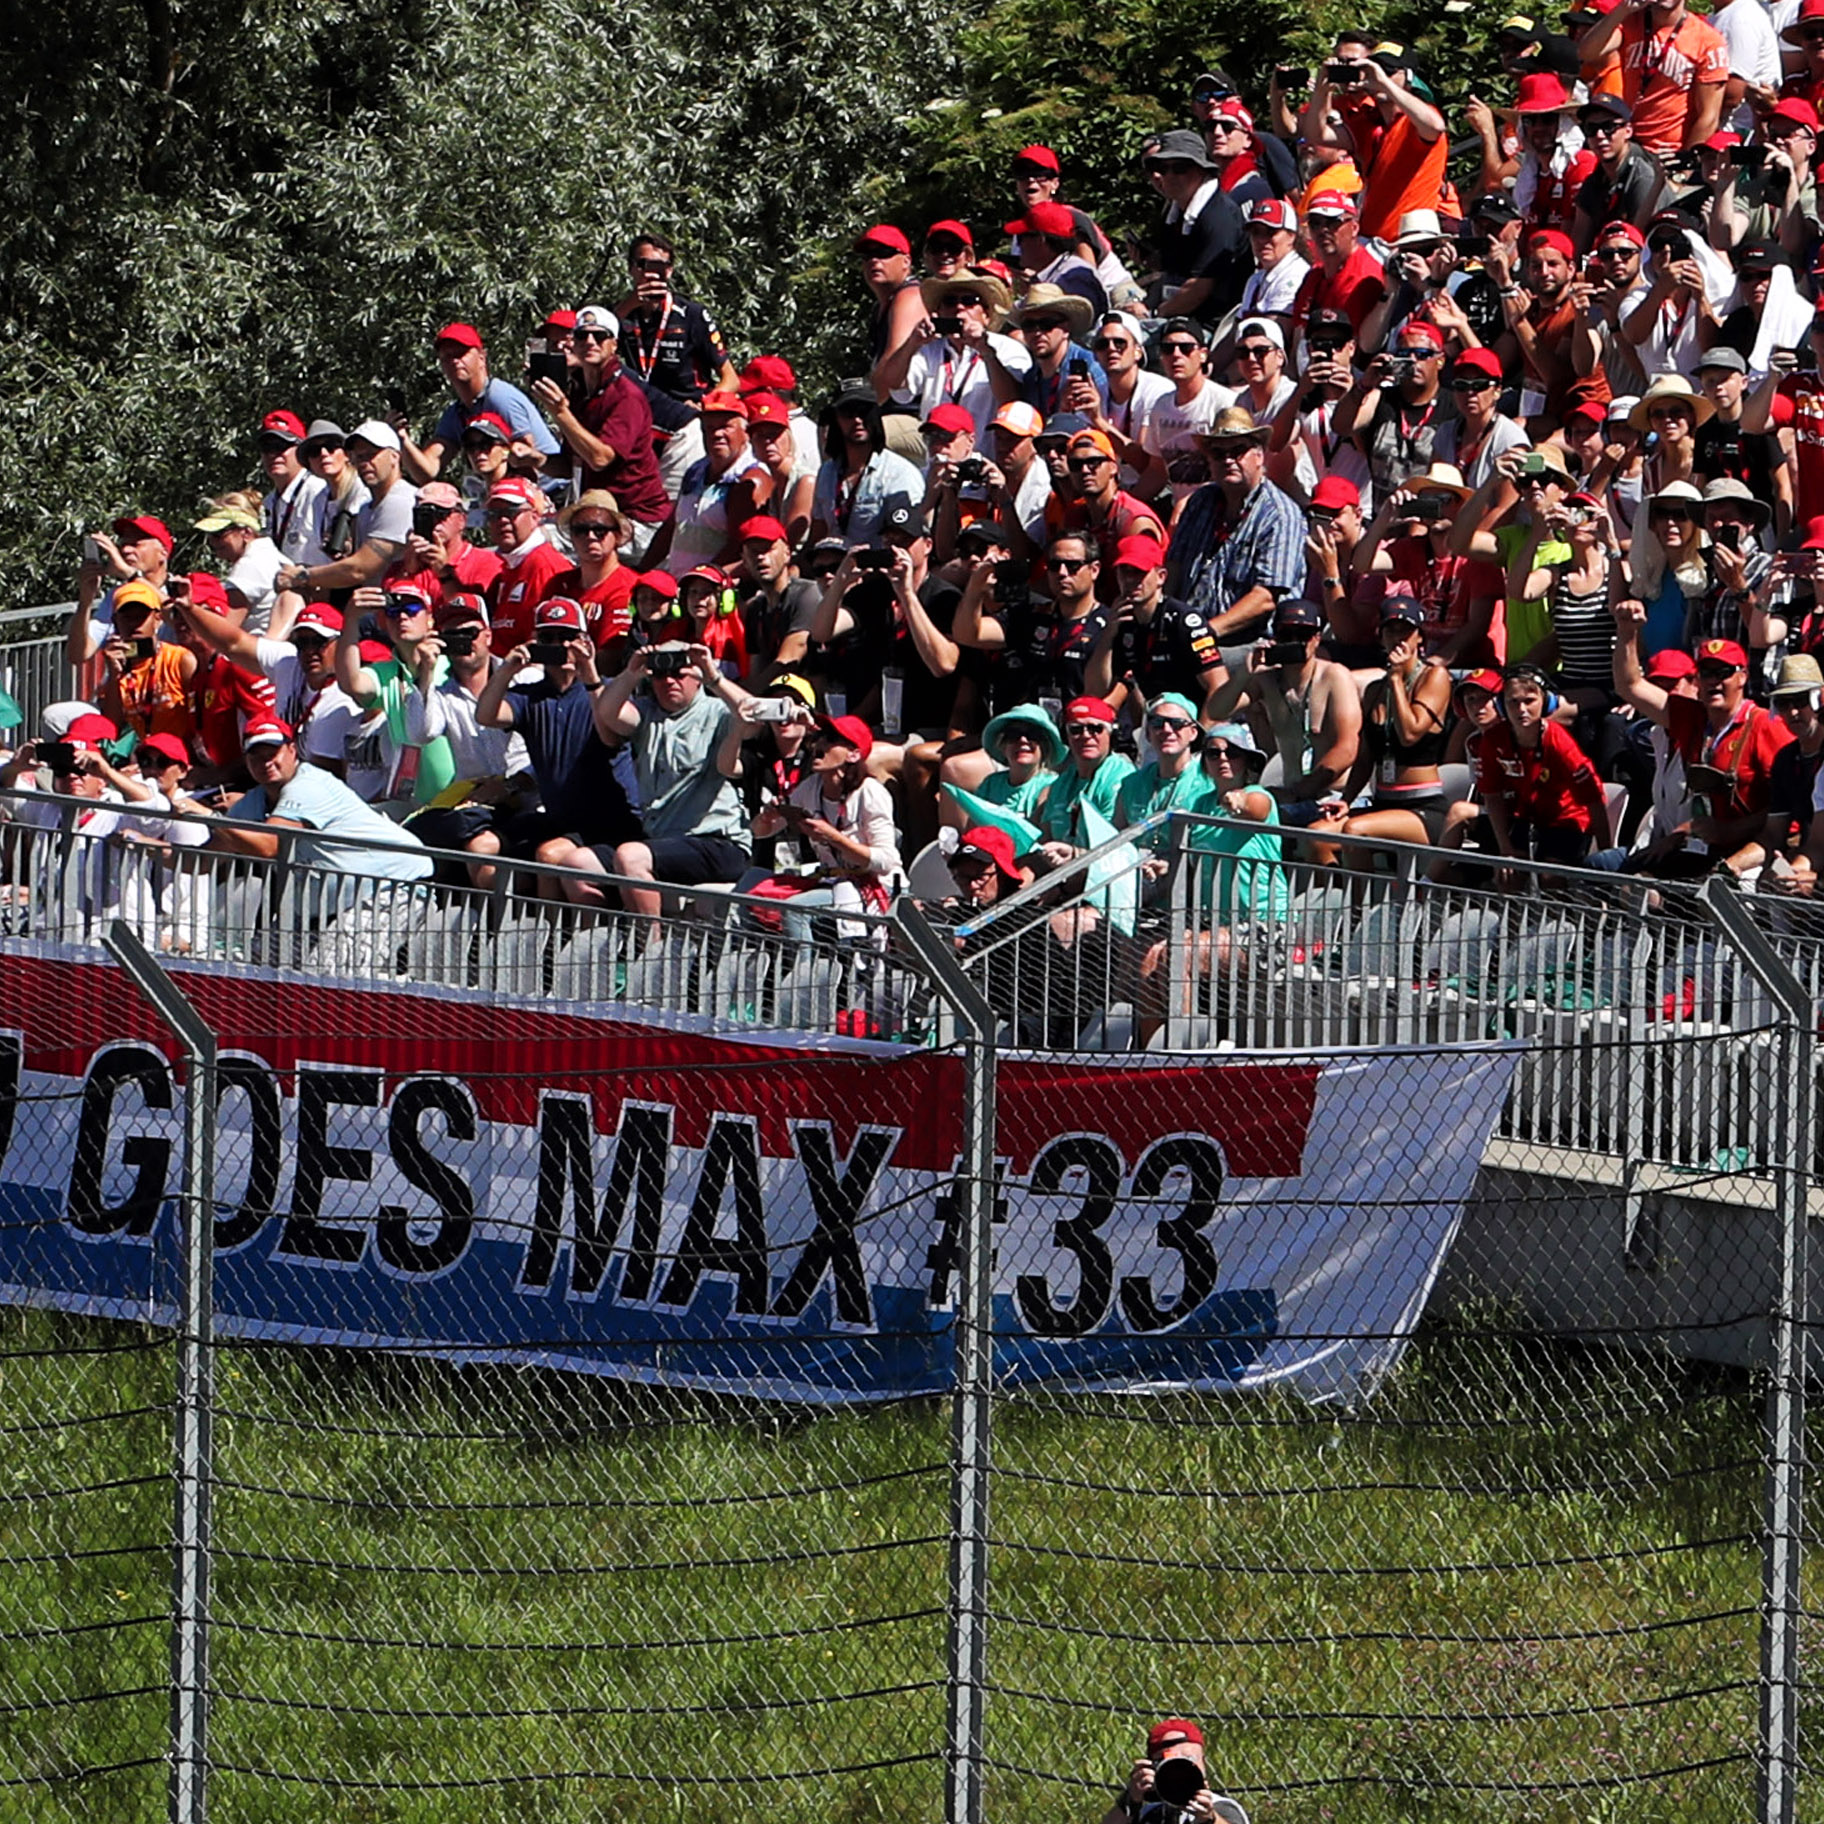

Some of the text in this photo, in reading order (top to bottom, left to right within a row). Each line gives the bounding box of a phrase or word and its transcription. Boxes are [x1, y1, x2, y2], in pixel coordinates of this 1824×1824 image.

[65, 1038, 479, 1282] GOES
[516, 1089, 903, 1335] MAX
[925, 1132, 1229, 1341] #33
